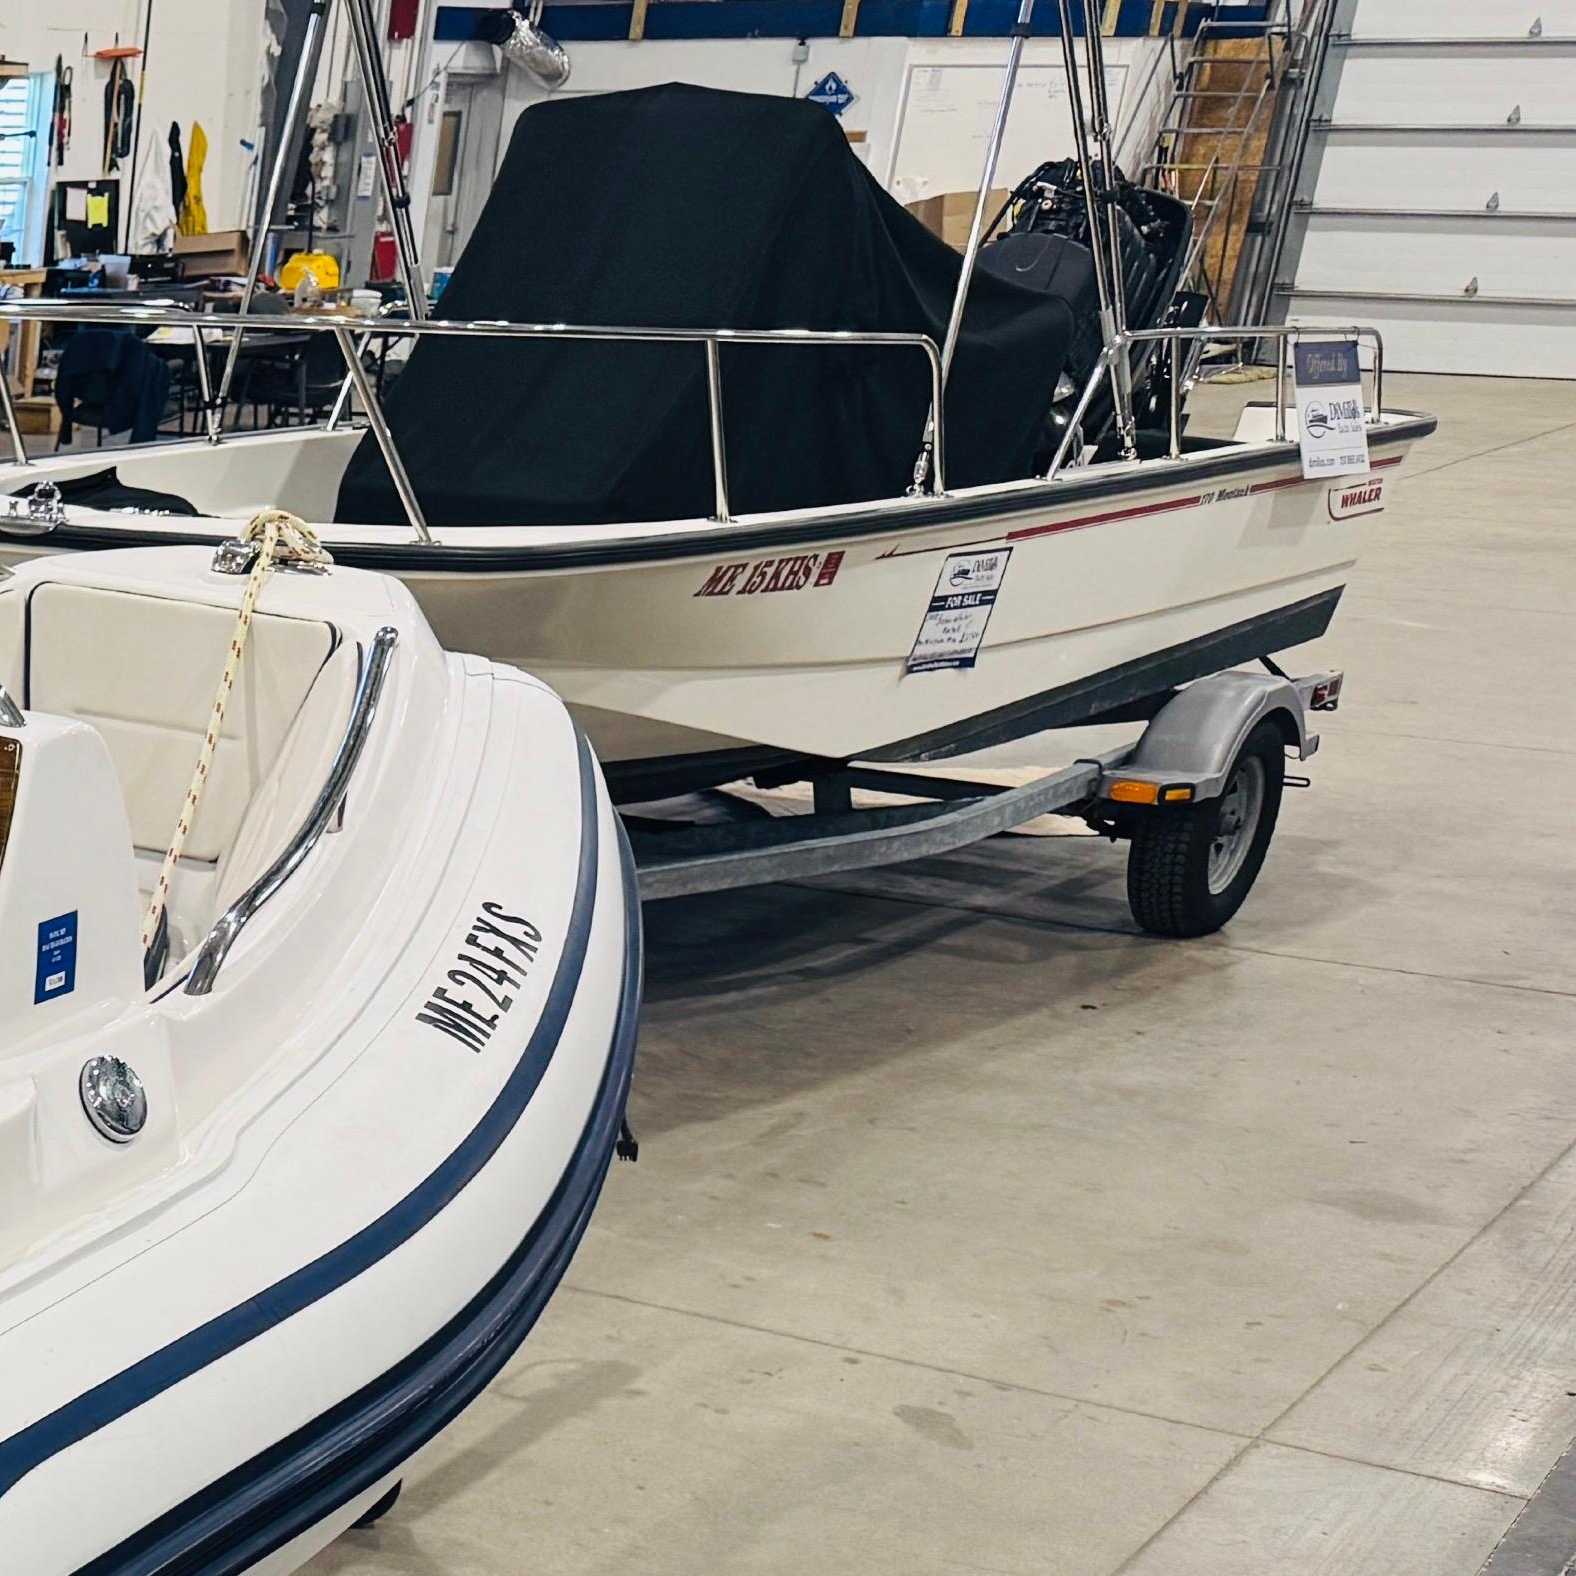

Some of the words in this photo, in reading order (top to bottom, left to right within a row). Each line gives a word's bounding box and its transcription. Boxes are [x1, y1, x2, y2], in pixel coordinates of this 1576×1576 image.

[1341, 486, 1382, 509] WHALER
[692, 562, 749, 597] ME
[945, 595, 962, 608] FOR
